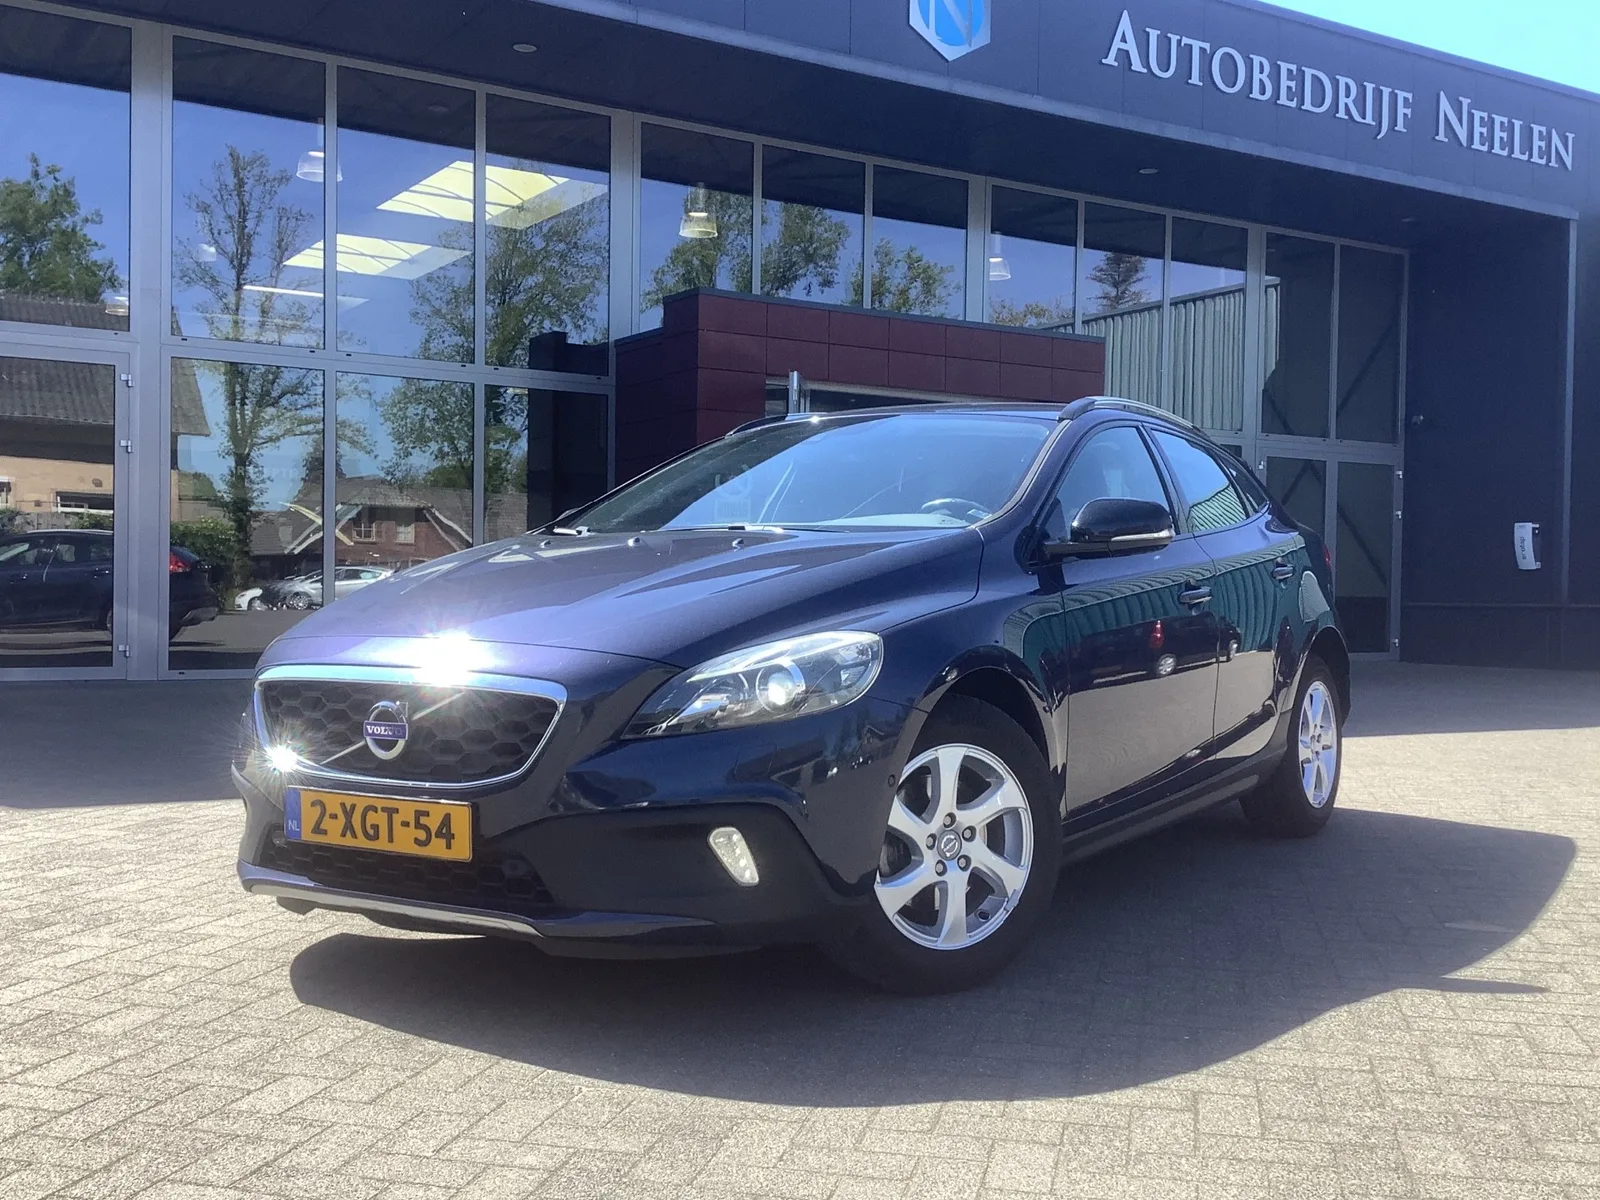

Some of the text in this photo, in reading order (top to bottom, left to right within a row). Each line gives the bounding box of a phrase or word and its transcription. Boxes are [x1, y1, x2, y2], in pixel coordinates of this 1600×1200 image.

[1101, 9, 1576, 172] AUTOBEDRIJF NEELEN
[365, 724, 404, 736] VOLVO
[287, 819, 301, 832] NL
[310, 799, 456, 850] 2-XGT-54
